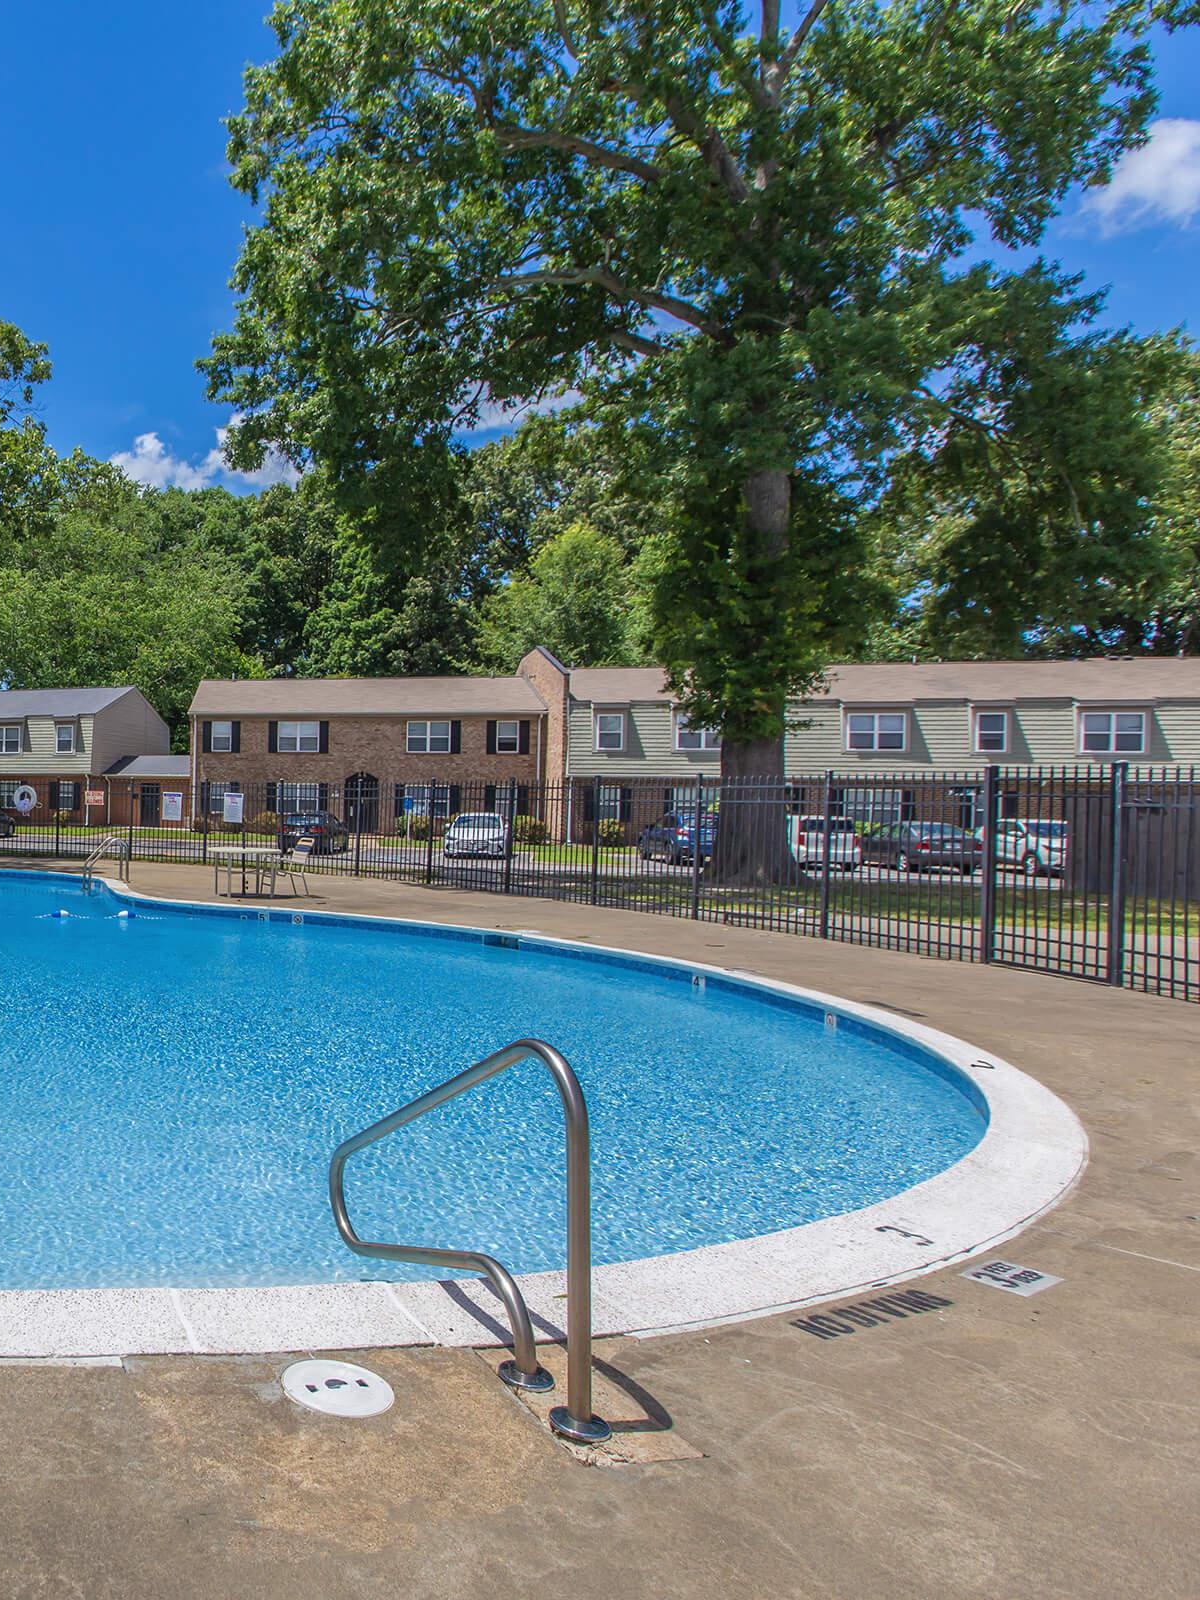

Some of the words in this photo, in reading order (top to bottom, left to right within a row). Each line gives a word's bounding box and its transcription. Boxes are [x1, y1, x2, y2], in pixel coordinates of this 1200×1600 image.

[982, 1262, 1016, 1274] FEET
[971, 1272, 1020, 1288] 3
[1010, 1270, 1044, 1283] DEEP
[789, 1315, 856, 1340] NO
[829, 1290, 955, 1328] DIVING
